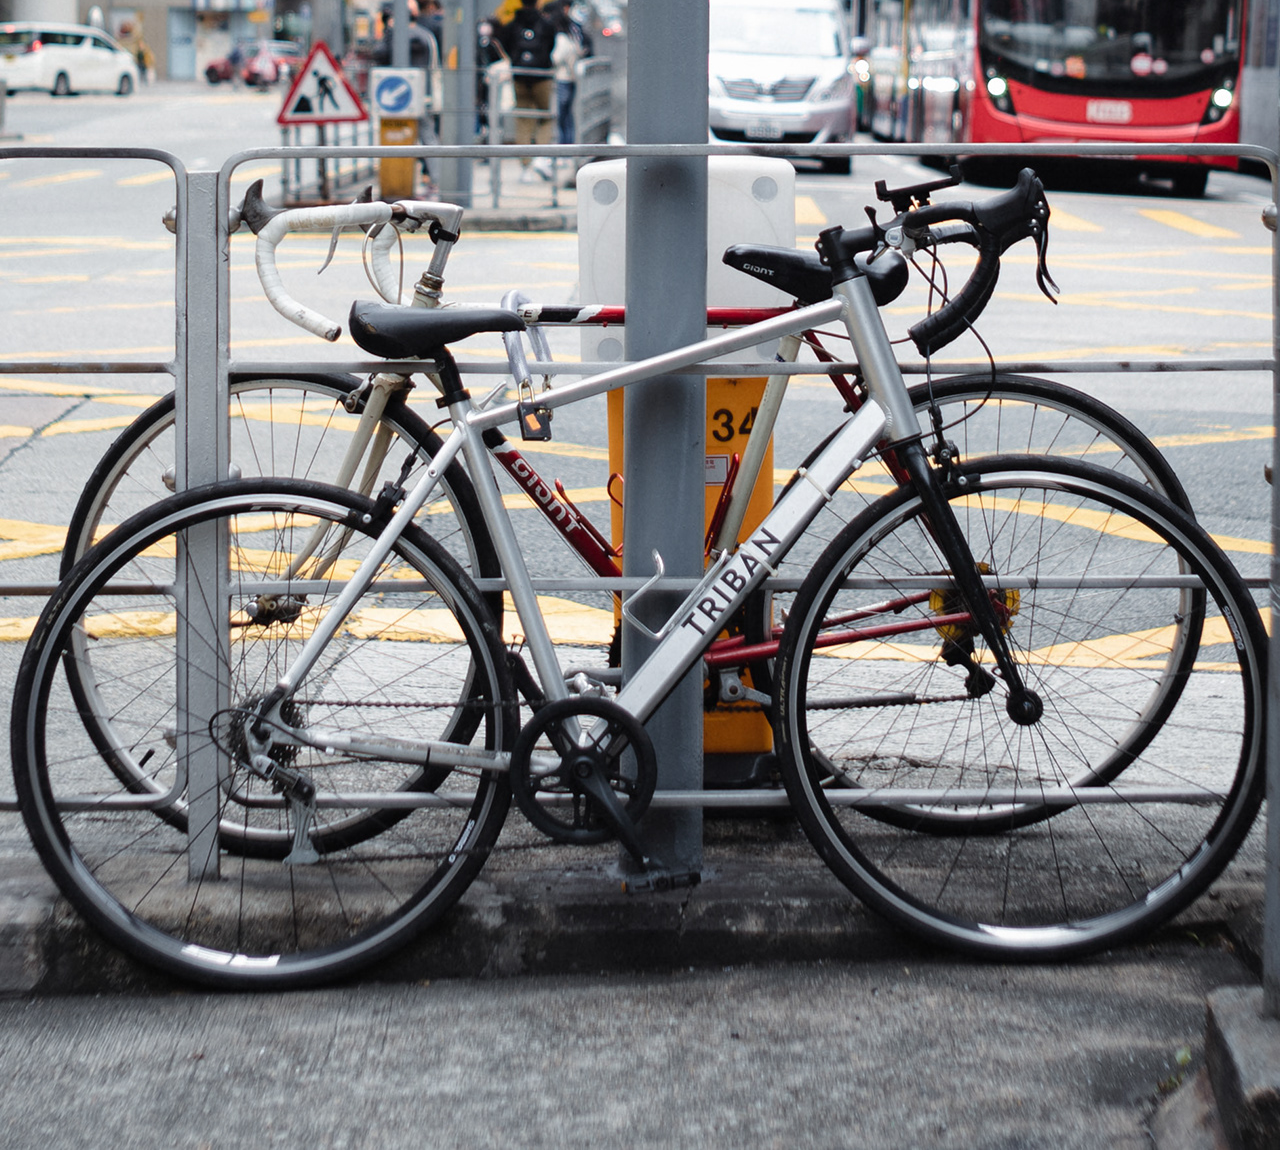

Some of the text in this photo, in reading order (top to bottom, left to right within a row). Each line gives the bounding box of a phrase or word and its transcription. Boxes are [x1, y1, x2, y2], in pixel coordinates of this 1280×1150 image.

[743, 263, 775, 276] GIANT
[511, 458, 581, 532] GIANT
[681, 527, 781, 636] TRIBAN
[1221, 605, 1245, 650] SHIMANO
